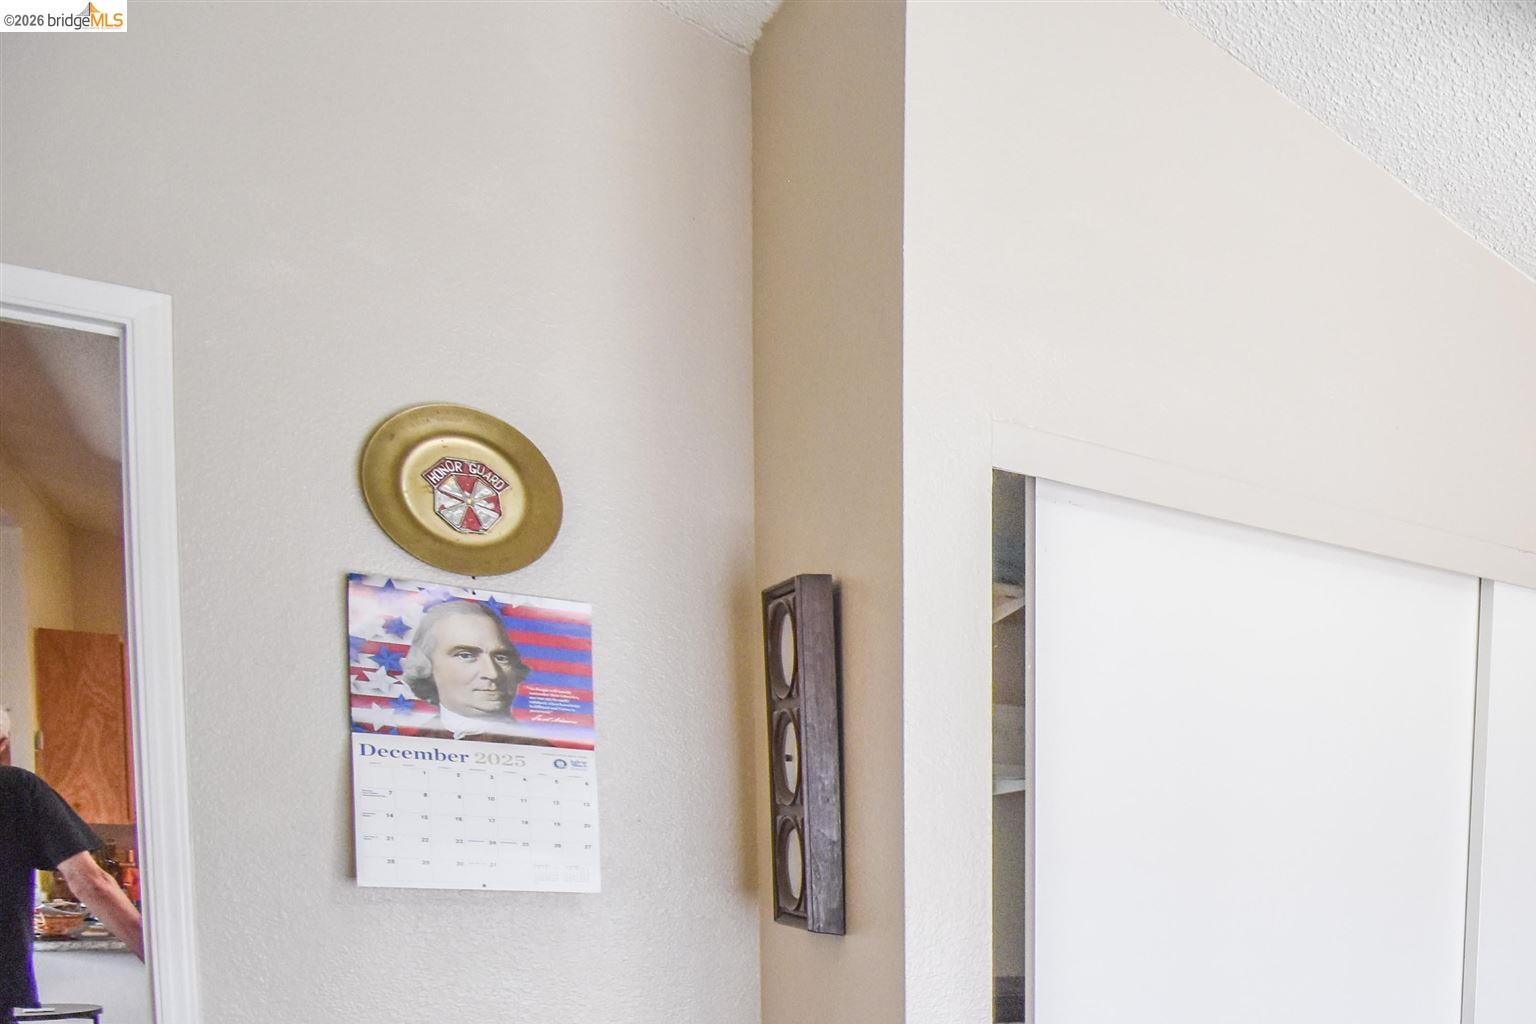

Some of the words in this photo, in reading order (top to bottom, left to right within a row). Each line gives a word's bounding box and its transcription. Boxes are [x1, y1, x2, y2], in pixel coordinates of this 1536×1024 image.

[427, 460, 463, 484] HONOR
[469, 462, 505, 490] GUARD
[359, 743, 470, 763] December
[473, 752, 527, 768] 2025
